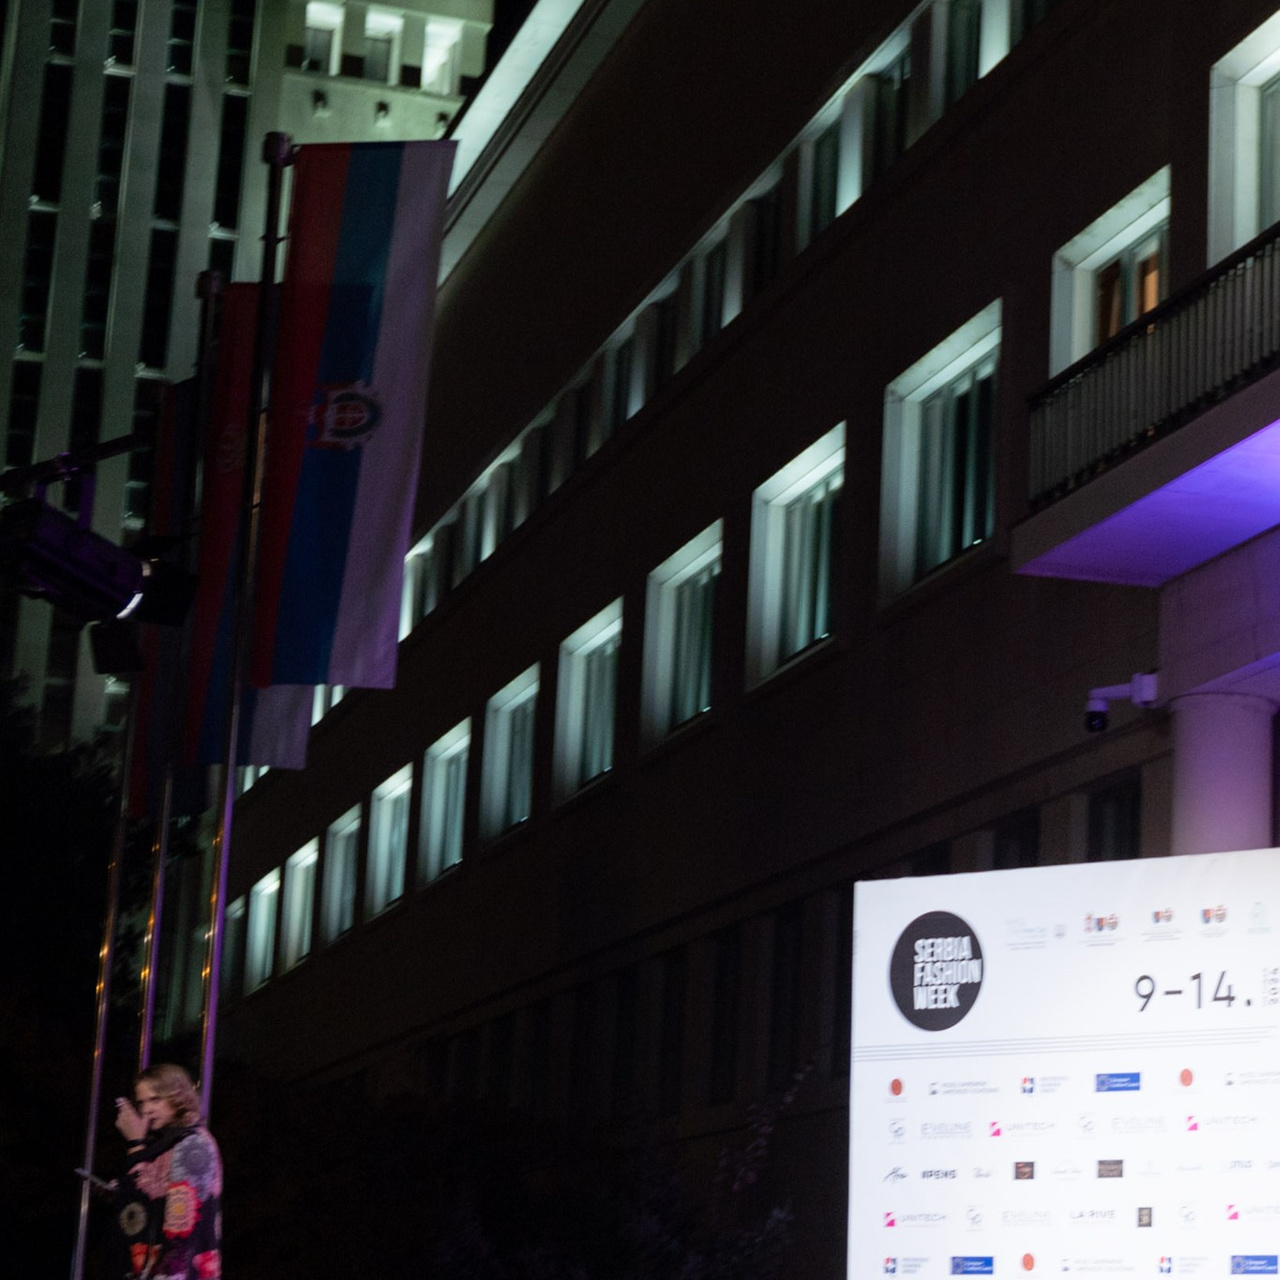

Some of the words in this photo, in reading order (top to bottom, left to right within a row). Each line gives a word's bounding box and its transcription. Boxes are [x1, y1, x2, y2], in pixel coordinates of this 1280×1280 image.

[915, 936, 972, 962] SERBIA
[914, 959, 982, 986] FASHION
[914, 984, 960, 1010] WEEK
